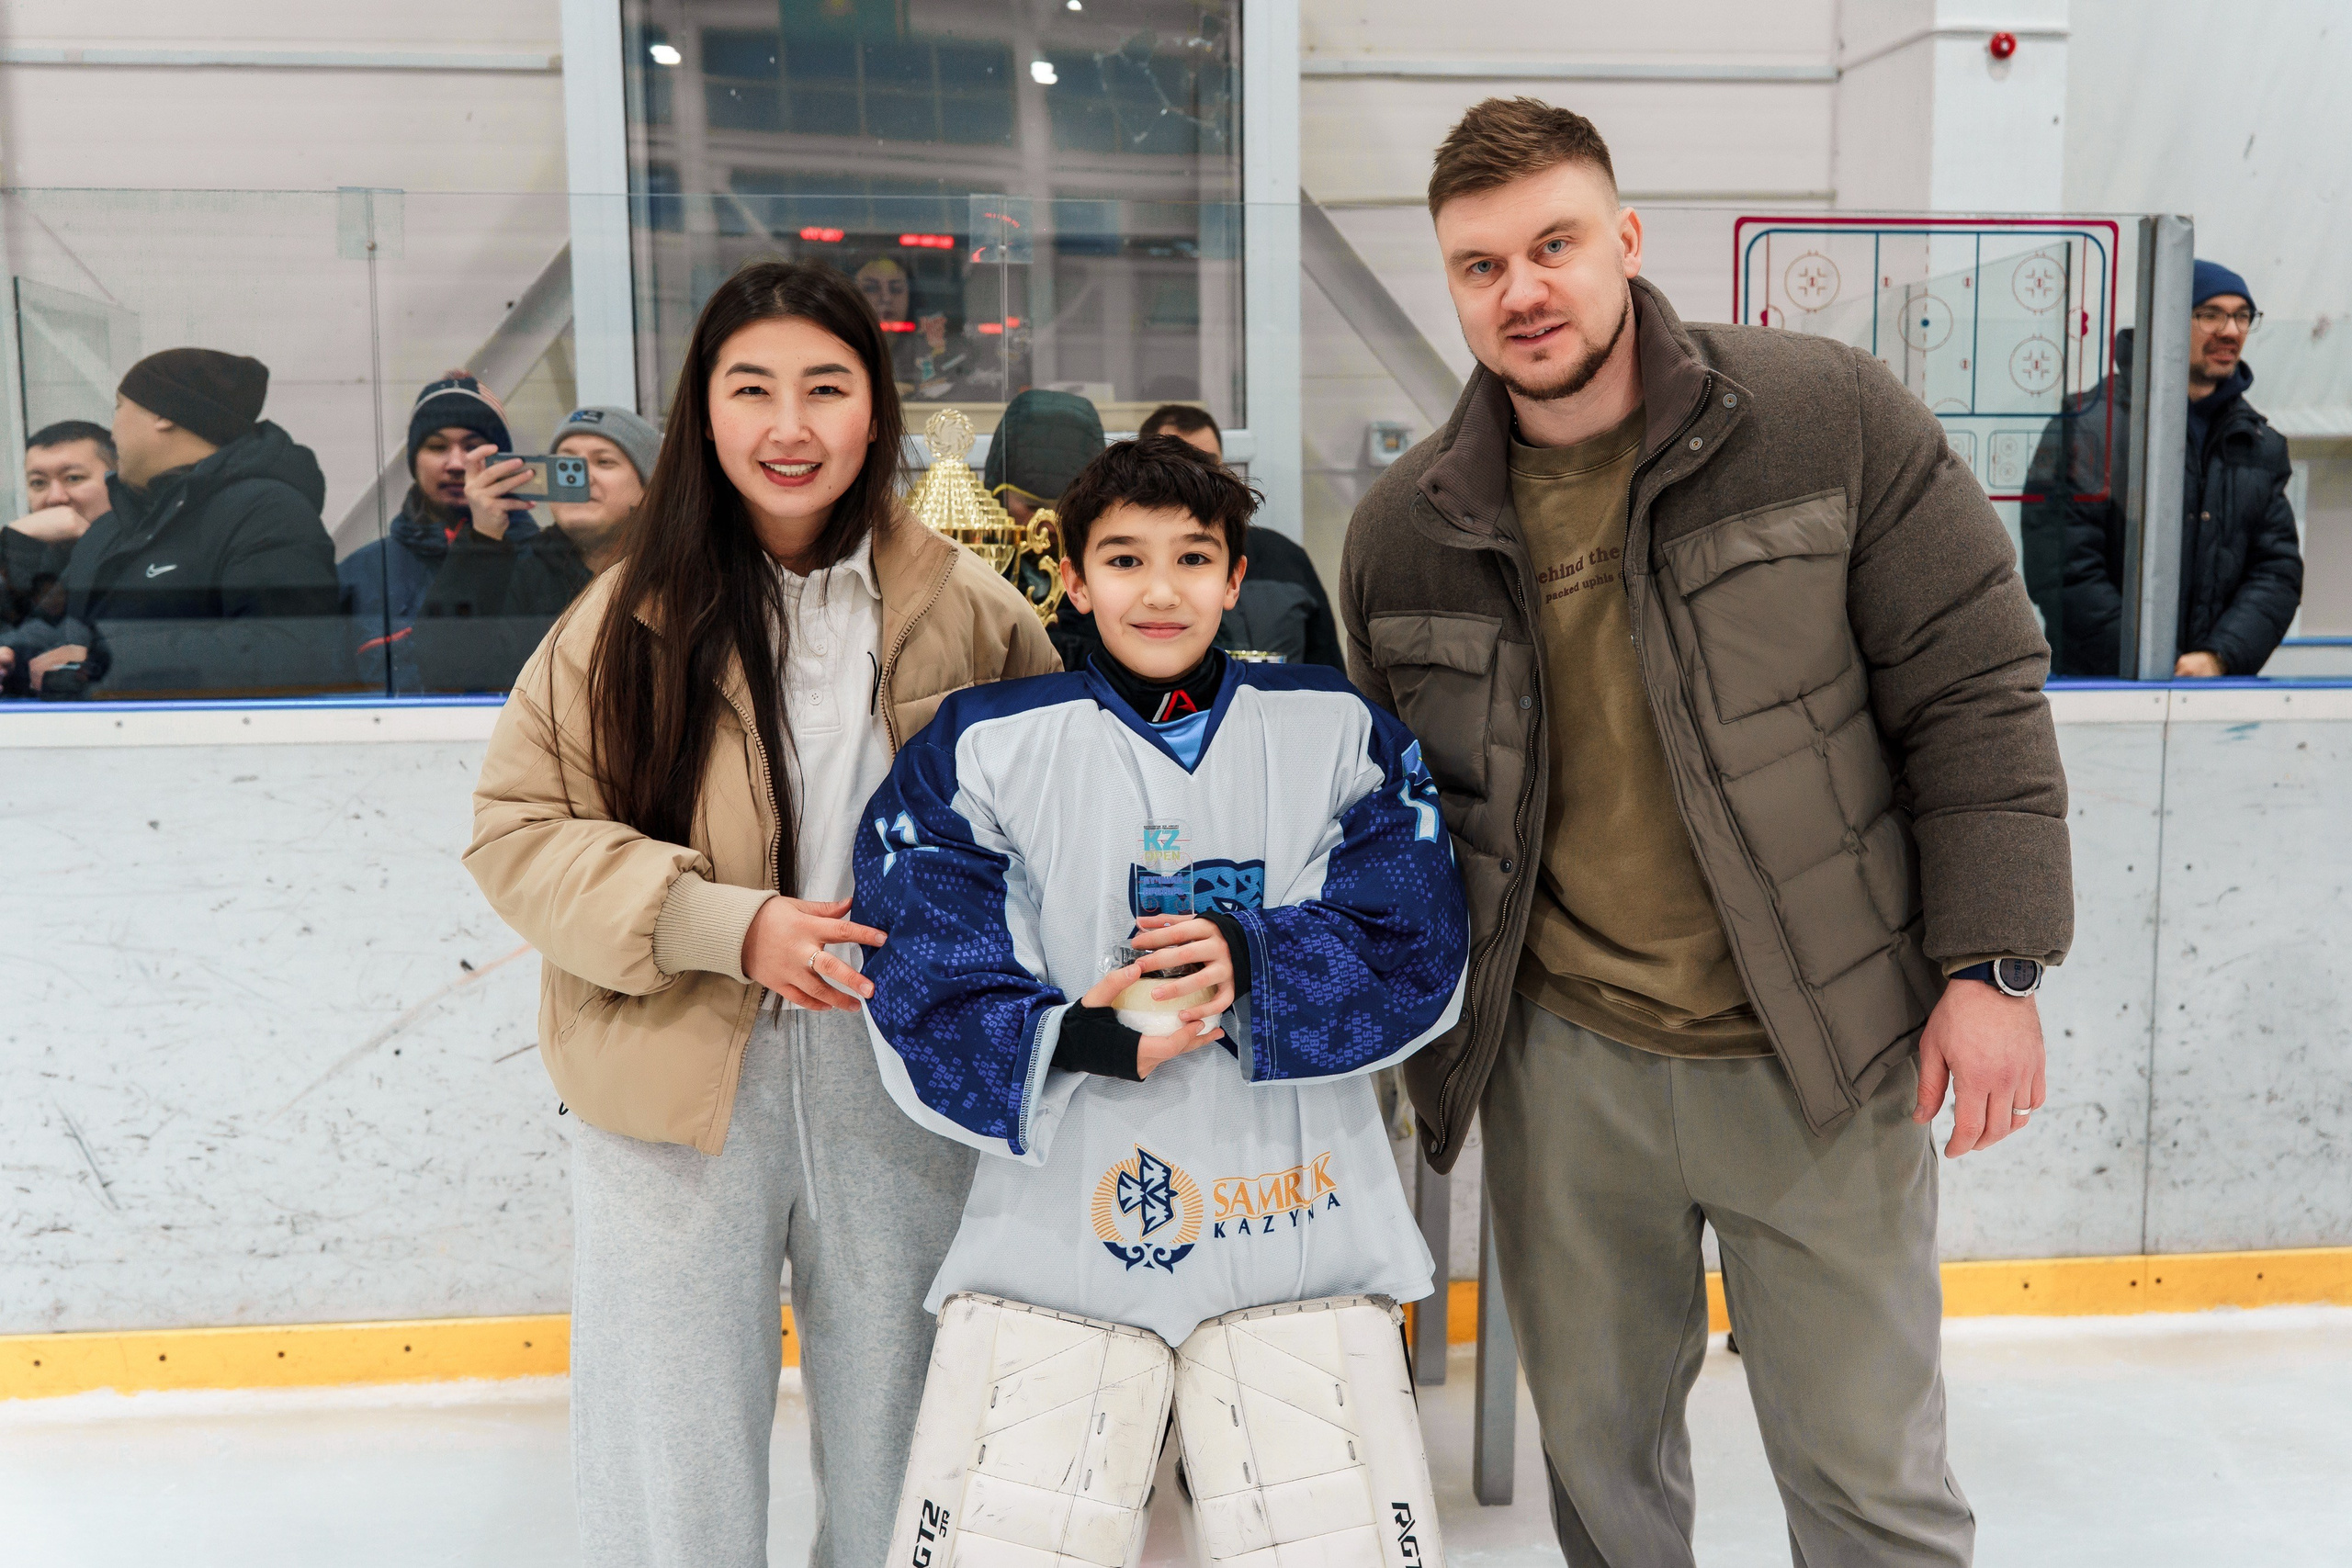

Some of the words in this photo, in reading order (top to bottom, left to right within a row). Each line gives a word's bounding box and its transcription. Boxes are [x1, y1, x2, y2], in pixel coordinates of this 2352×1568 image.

[1536, 555, 1584, 584] ehind
[1589, 547, 1621, 567] the
[1545, 581, 1579, 604] packed
[1143, 829, 1181, 852] KZ
[1144, 851, 1181, 862] OPEN
[1214, 1192, 1341, 1239] KAZYNA
